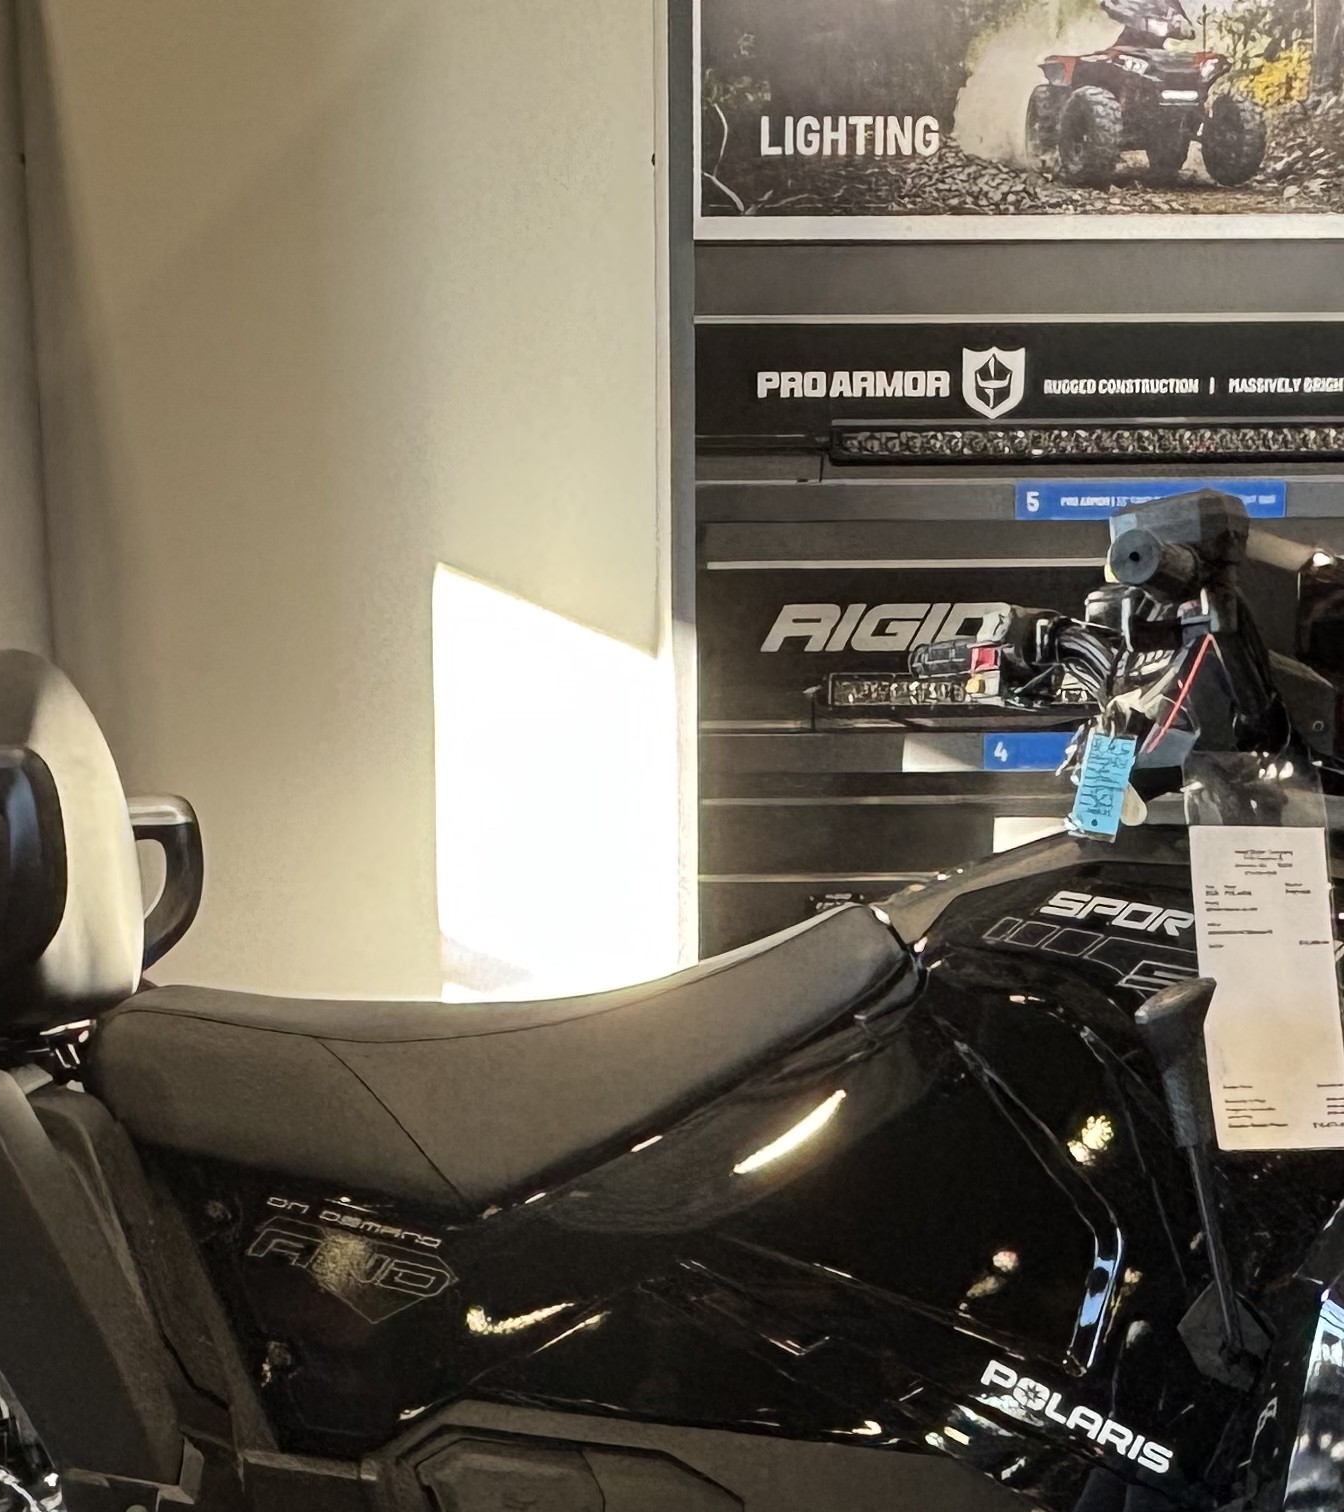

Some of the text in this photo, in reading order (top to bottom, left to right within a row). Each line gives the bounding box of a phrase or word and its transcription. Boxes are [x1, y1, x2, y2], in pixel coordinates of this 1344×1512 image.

[759, 115, 940, 158] LIGHTING
[1043, 378, 1200, 395] RUGGED CONSTRUCTION
[1228, 377, 1301, 394] MASSIVELY
[1025, 491, 1040, 512] 5
[993, 741, 1008, 763] 4
[266, 1195, 443, 1249] ON DEMAND
[979, 1359, 1175, 1475] POLARIS
